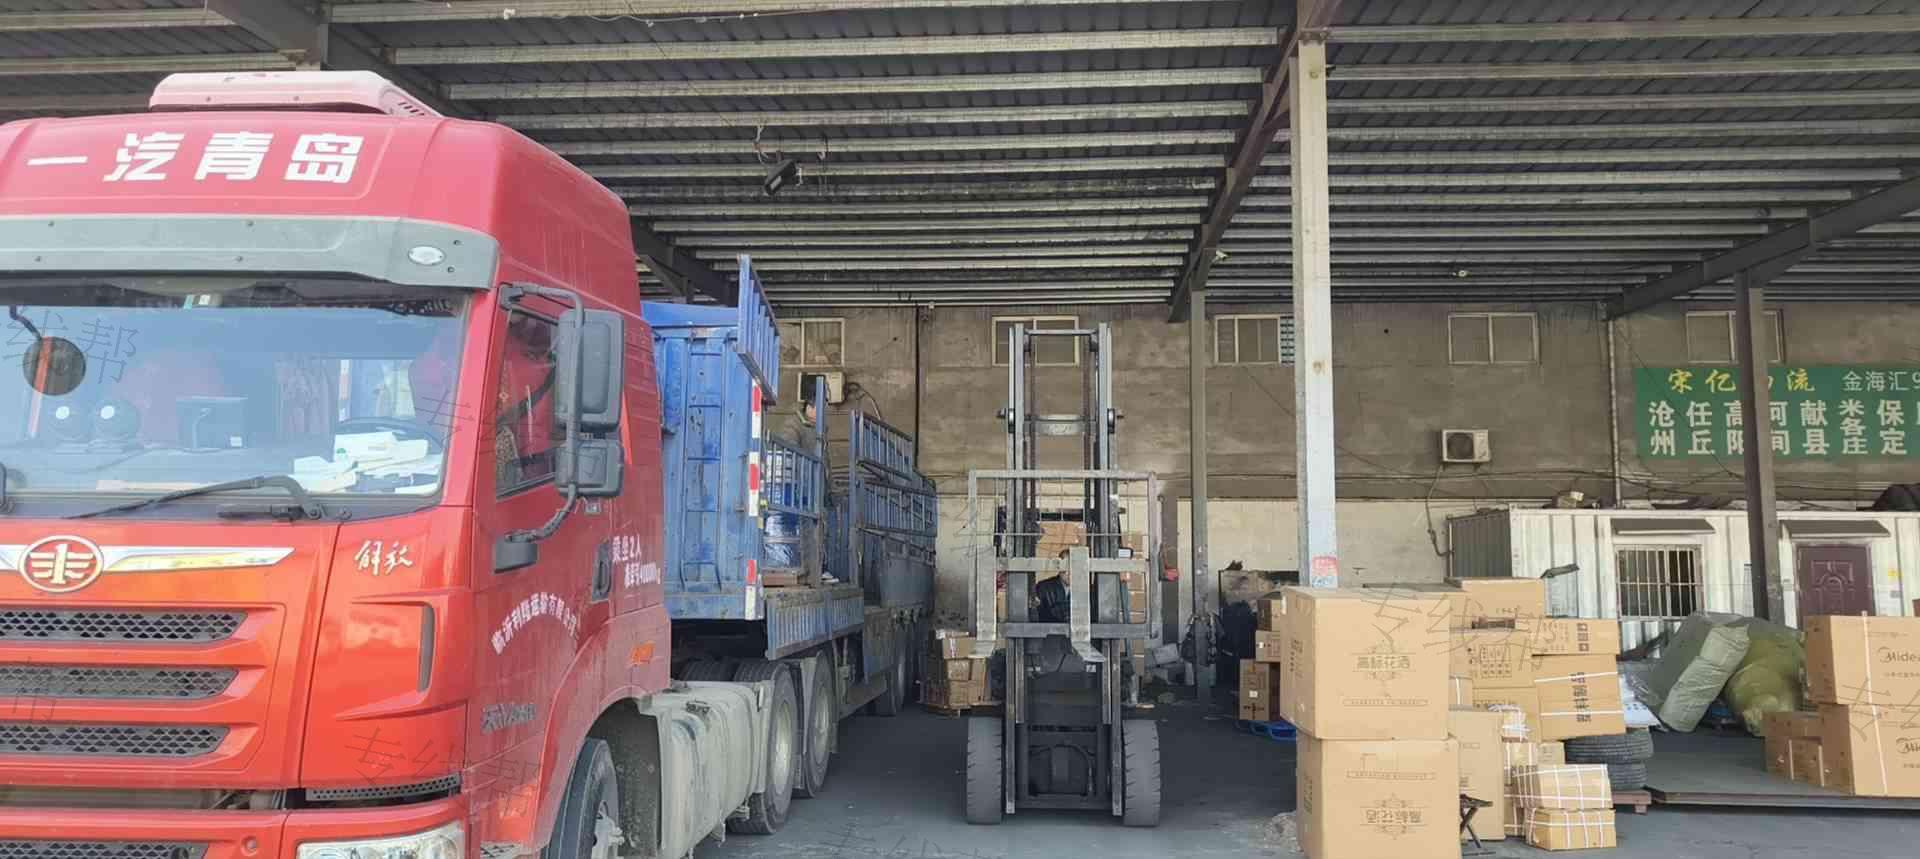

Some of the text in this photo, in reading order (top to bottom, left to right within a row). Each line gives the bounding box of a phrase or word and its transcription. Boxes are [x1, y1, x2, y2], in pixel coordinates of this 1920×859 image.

[27, 131, 364, 184] 一汽青岛
[1667, 368, 1816, 394] 宋亿流
[1878, 646, 1920, 664] Mide
